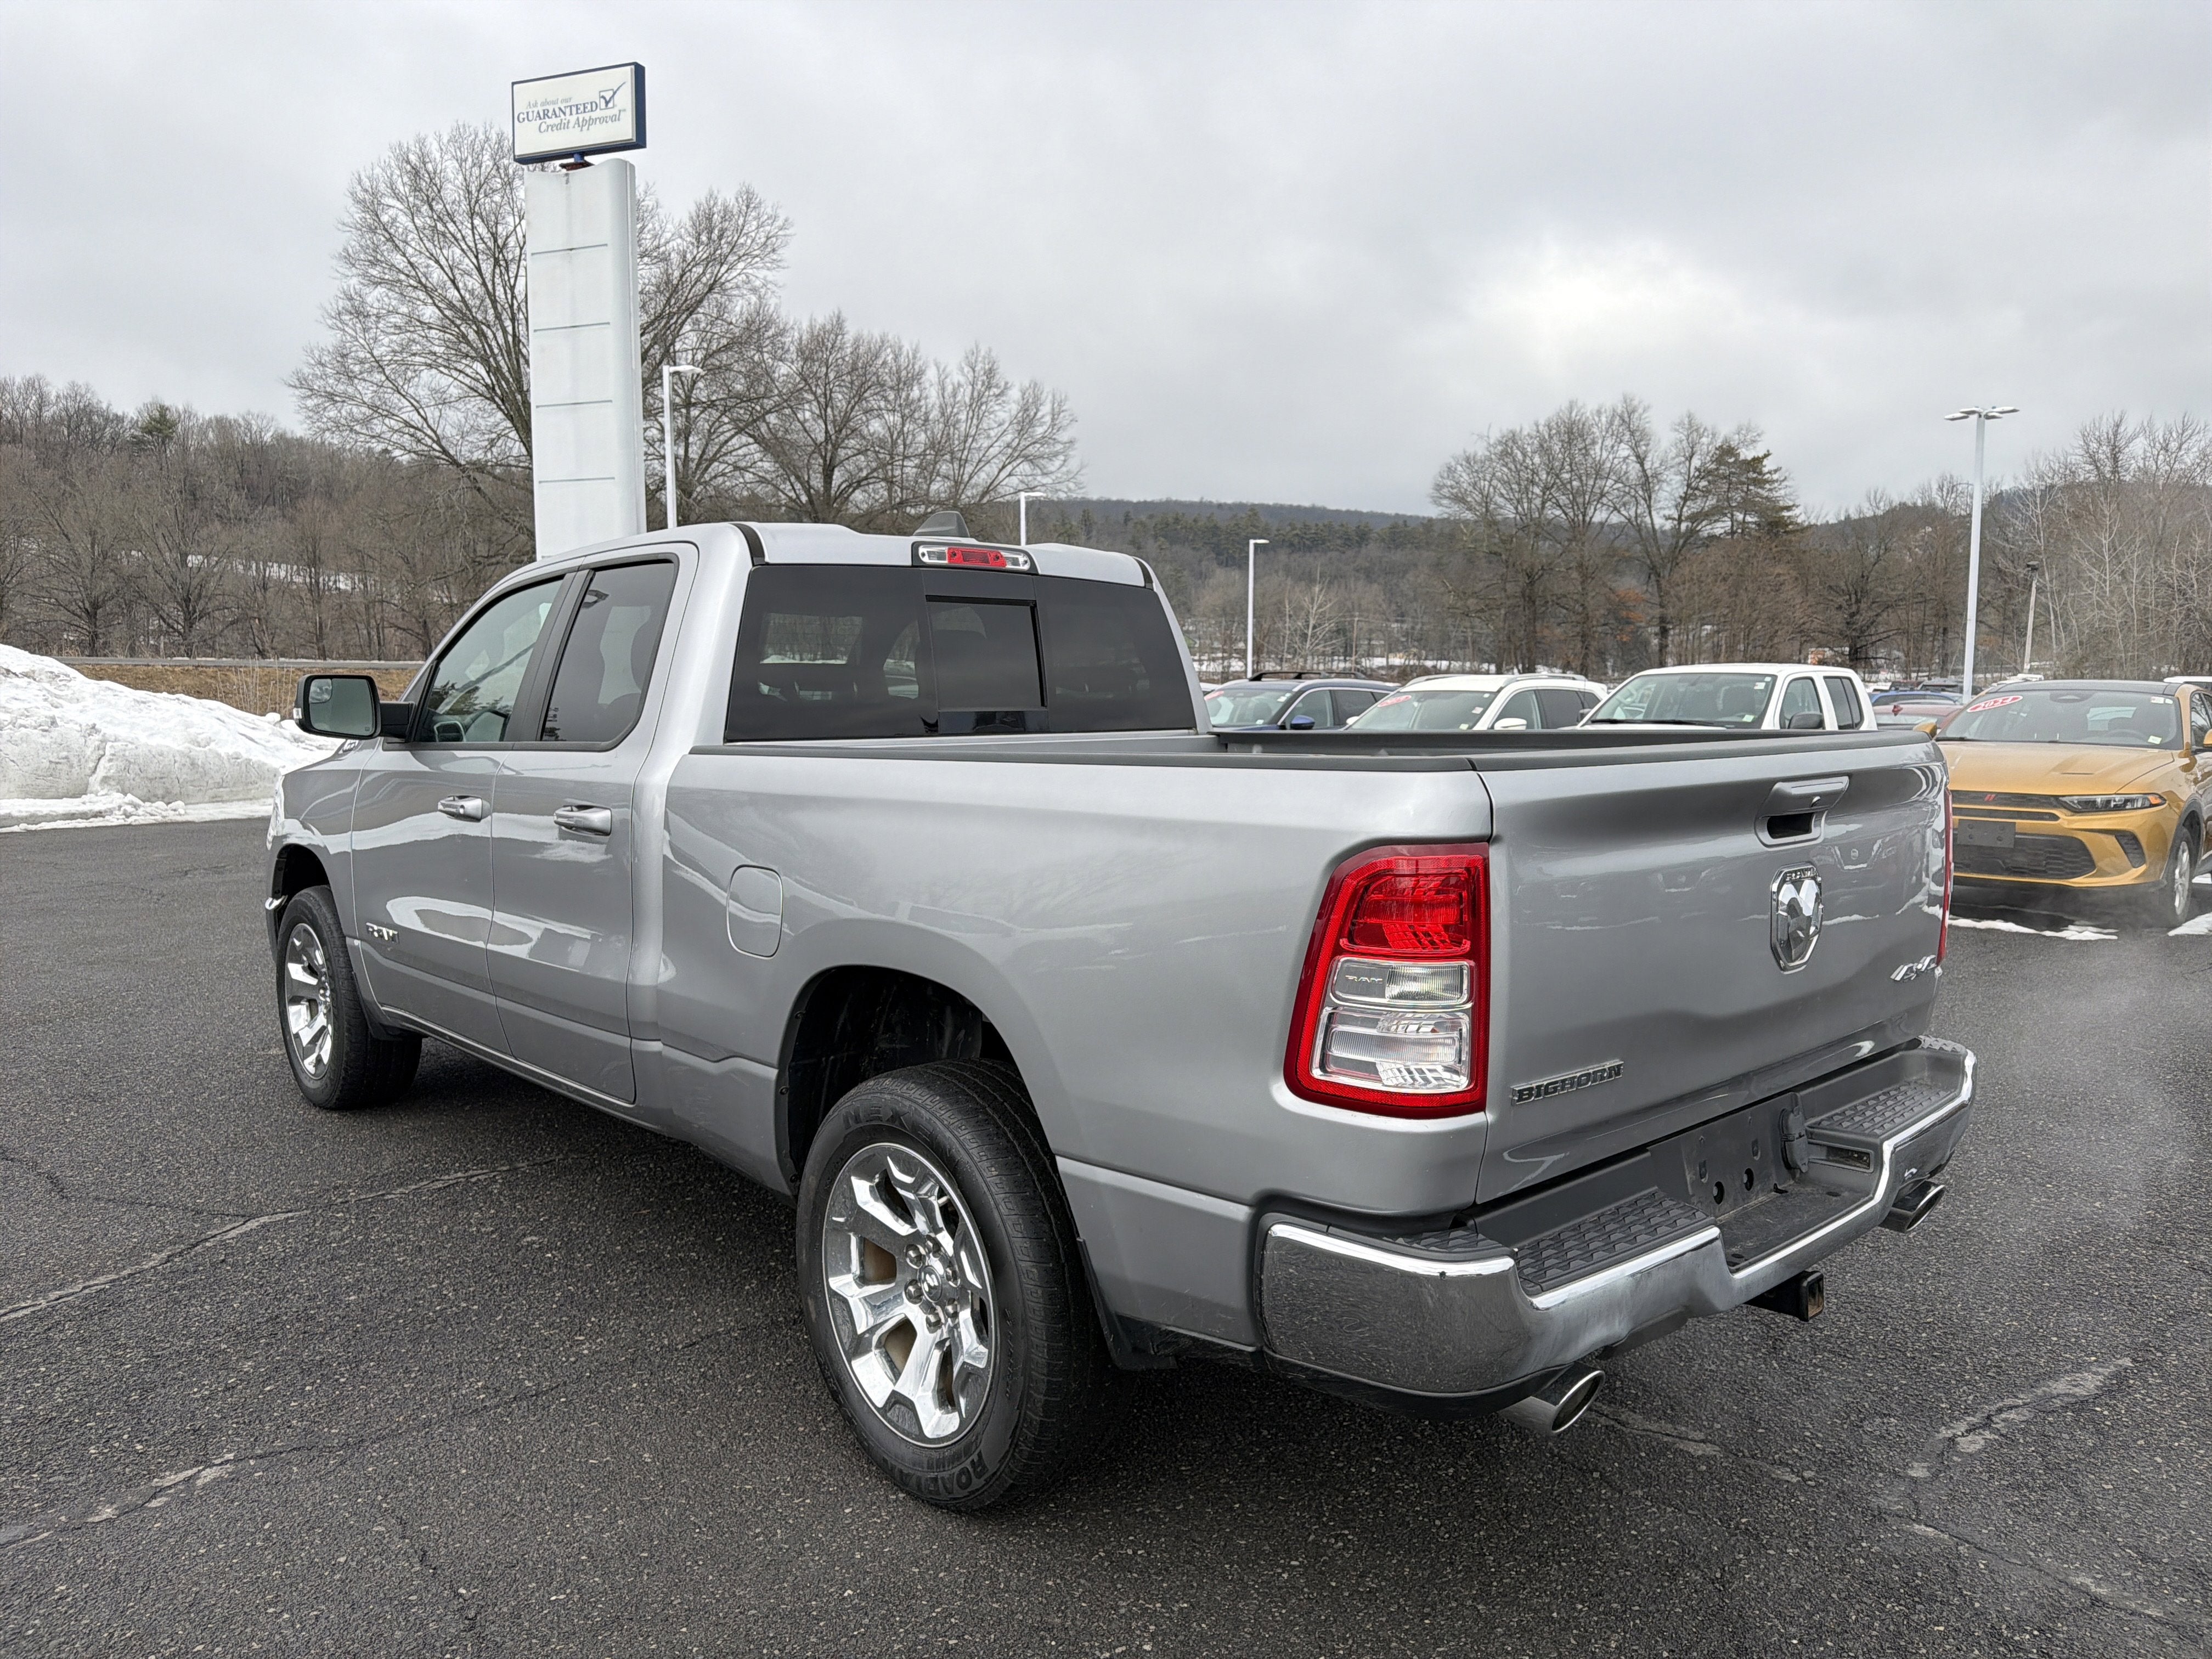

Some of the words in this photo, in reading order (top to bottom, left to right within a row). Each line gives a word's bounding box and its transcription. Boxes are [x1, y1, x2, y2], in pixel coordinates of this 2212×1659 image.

[517, 101, 598, 123] GUARANTEED
[526, 101, 538, 109] Ask
[540, 98, 558, 108] about
[561, 97, 573, 105] our
[538, 117, 571, 133] Credit
[573, 109, 622, 132] Approval
[1510, 1059, 1624, 1105] BIGHORN
